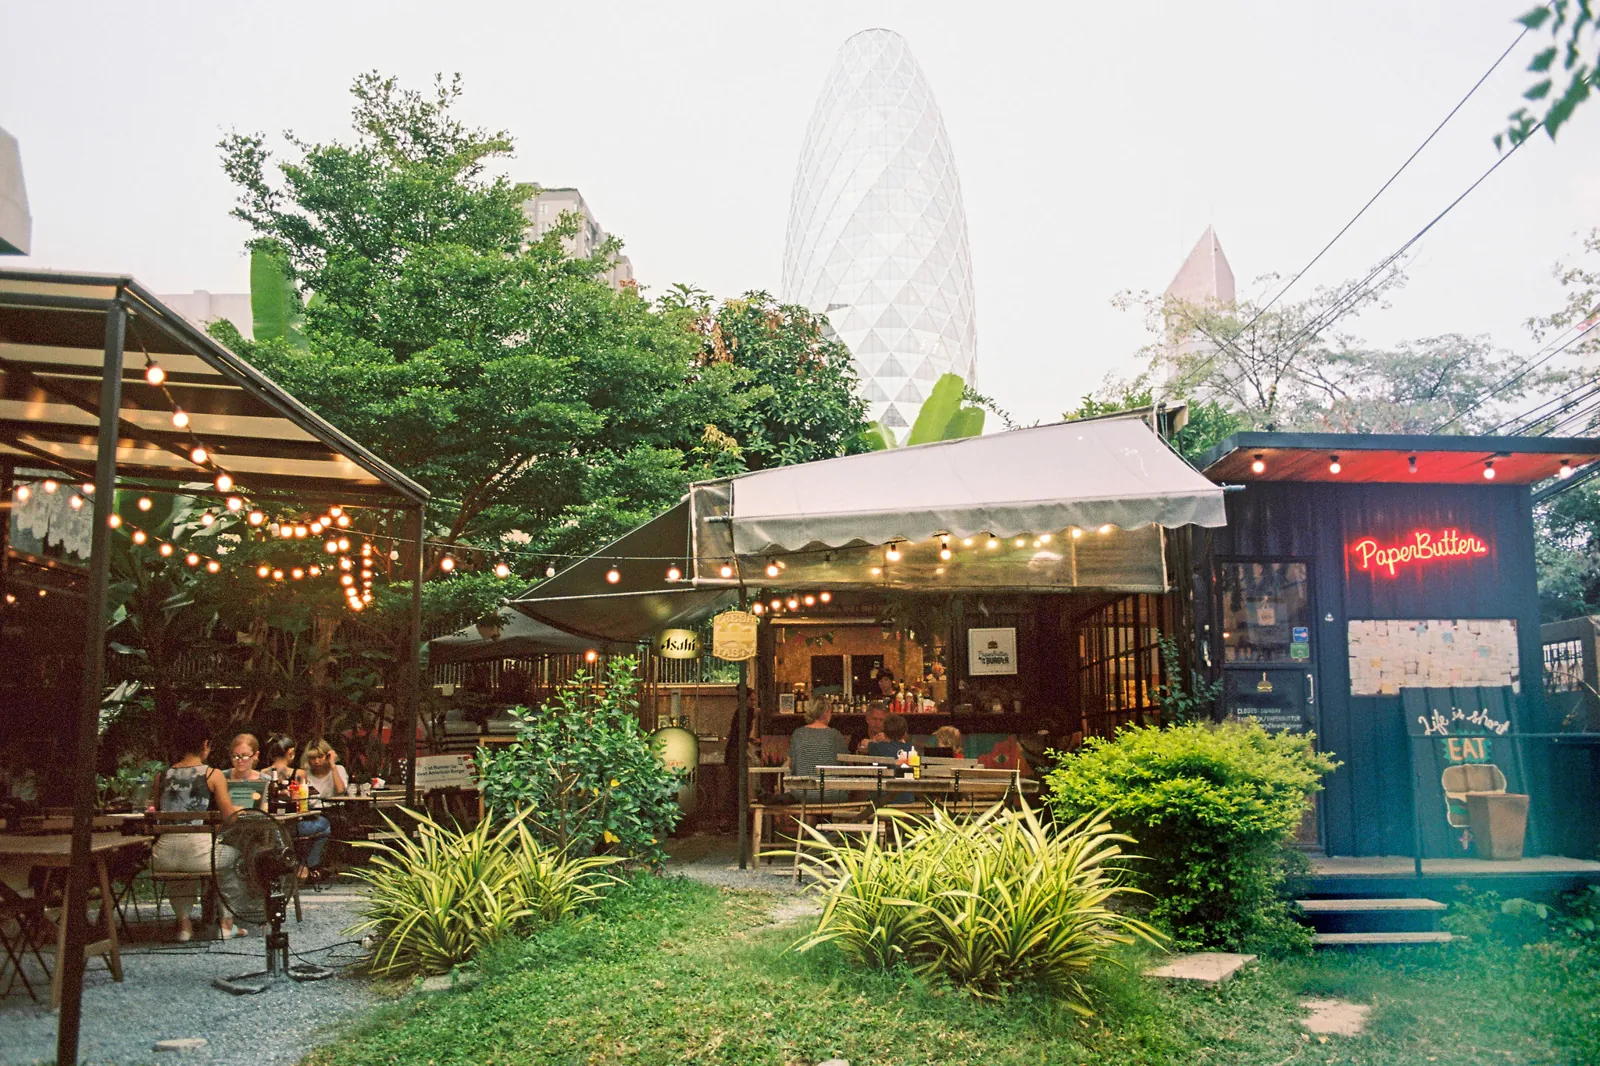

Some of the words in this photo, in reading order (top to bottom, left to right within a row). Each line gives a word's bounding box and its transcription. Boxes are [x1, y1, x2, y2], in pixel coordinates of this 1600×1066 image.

[660, 636, 696, 651] Asahi
[1418, 709, 1449, 735] Life
[1451, 707, 1465, 721] is
[1466, 708, 1510, 735] short
[1447, 737, 1486, 761] EAT
